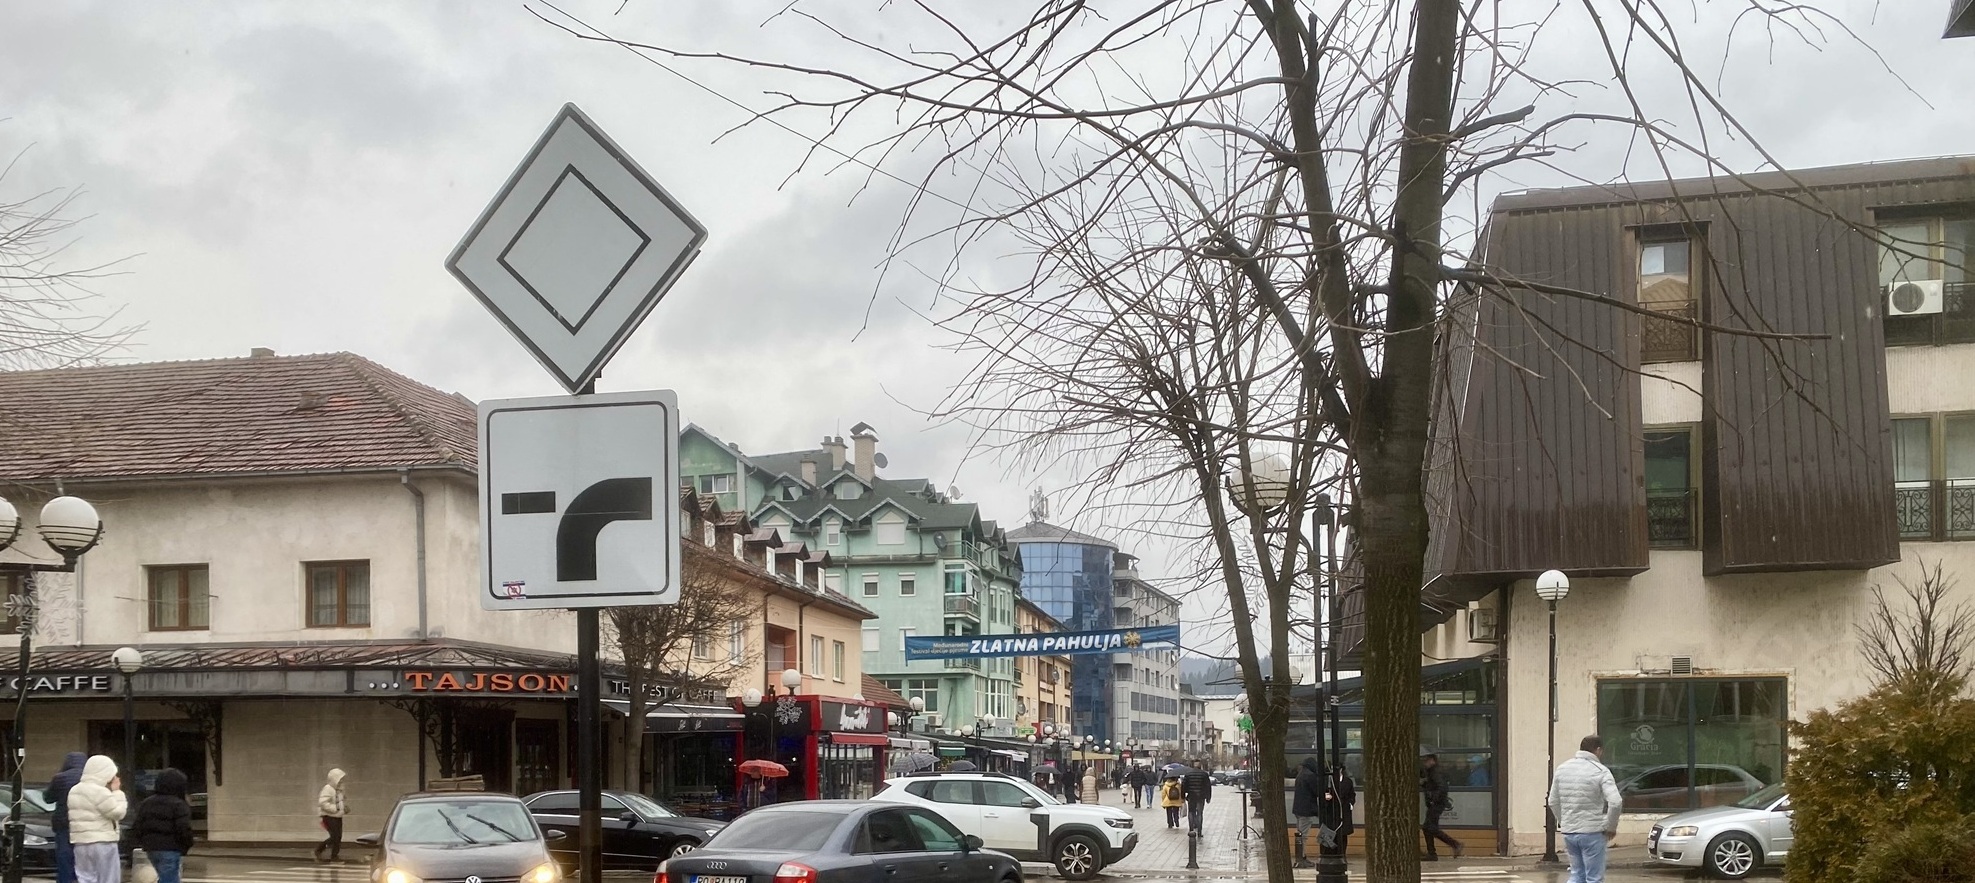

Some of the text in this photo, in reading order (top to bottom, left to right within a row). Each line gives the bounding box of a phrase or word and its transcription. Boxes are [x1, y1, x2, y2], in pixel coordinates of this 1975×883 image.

[969, 633, 1121, 654] ZLATNA PAHULJA
[611, 680, 631, 694] TH
